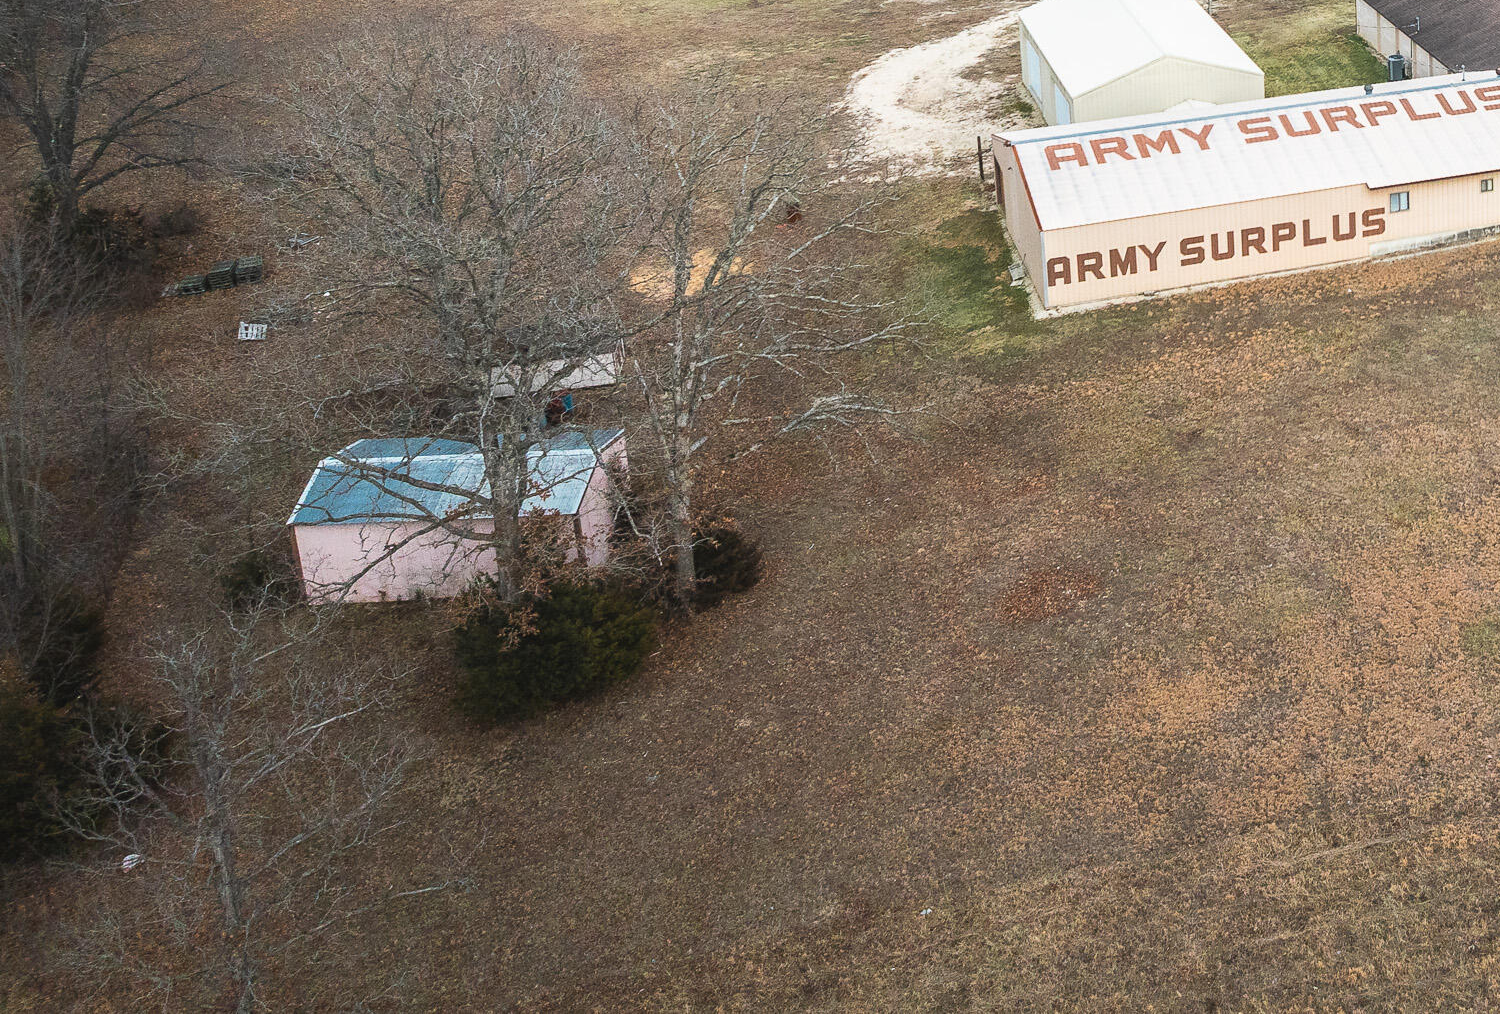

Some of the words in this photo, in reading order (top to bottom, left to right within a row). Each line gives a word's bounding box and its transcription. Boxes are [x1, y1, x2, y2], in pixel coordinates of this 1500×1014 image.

[1044, 123, 1215, 171] ARMY
[1047, 241, 1168, 287] ARMY
[1180, 207, 1387, 267] SURPLUS
